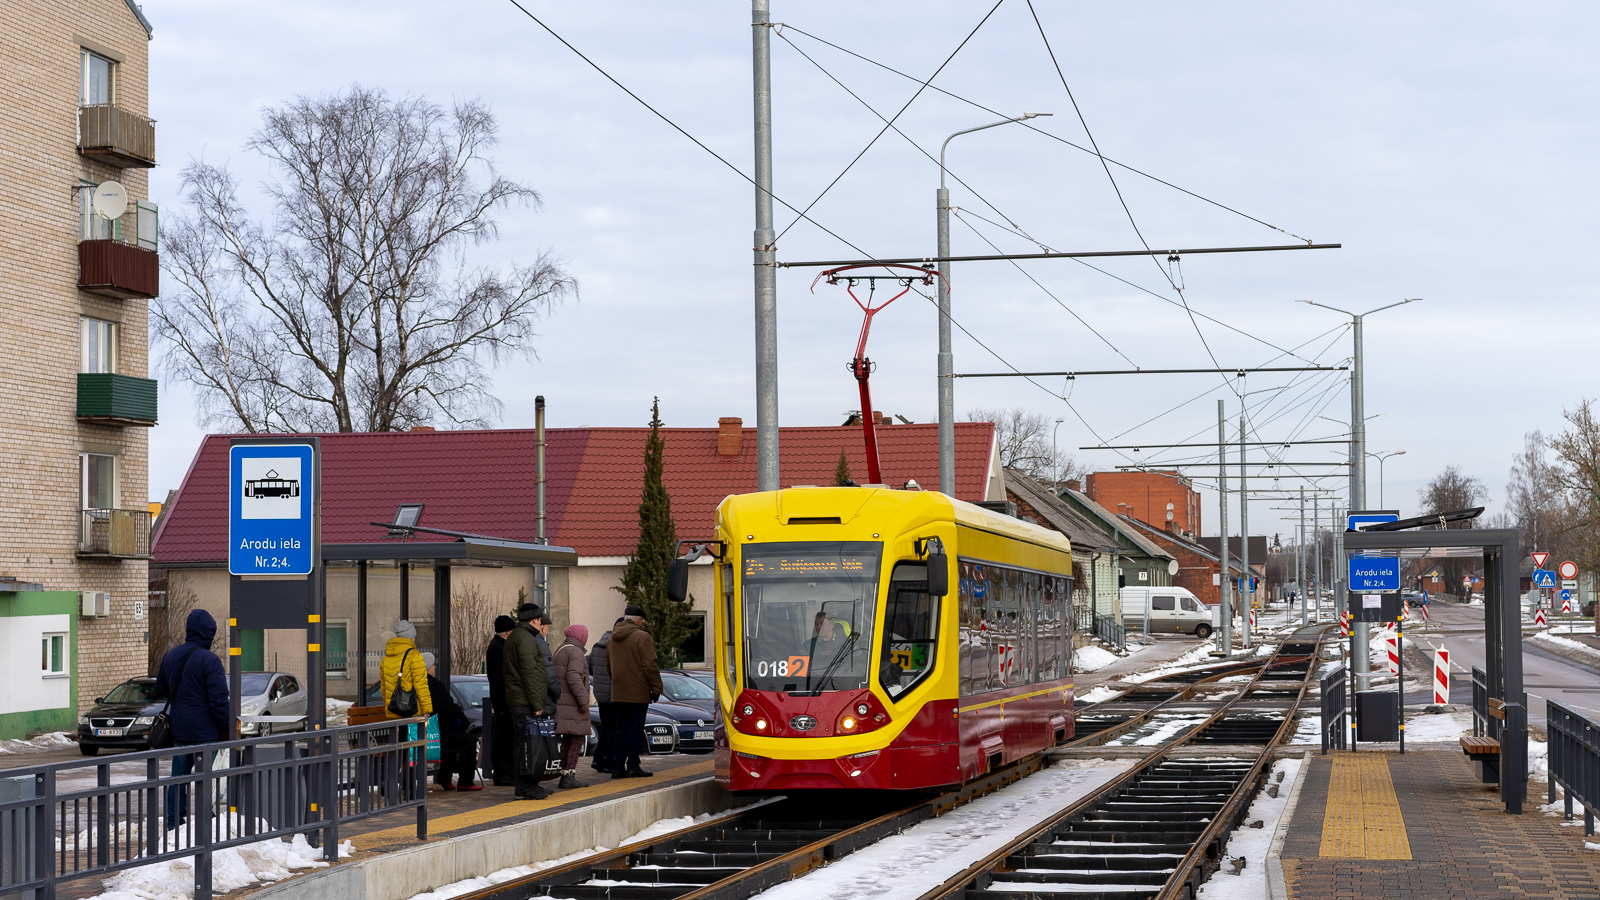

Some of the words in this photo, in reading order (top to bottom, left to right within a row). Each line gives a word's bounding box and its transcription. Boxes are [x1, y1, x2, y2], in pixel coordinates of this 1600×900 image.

[240, 538, 276, 549] Arodu
[280, 538, 301, 549] iela
[255, 556, 270, 568] Nr.
[271, 557, 291, 568] 2;4.
[136, 603, 141, 614] 65
